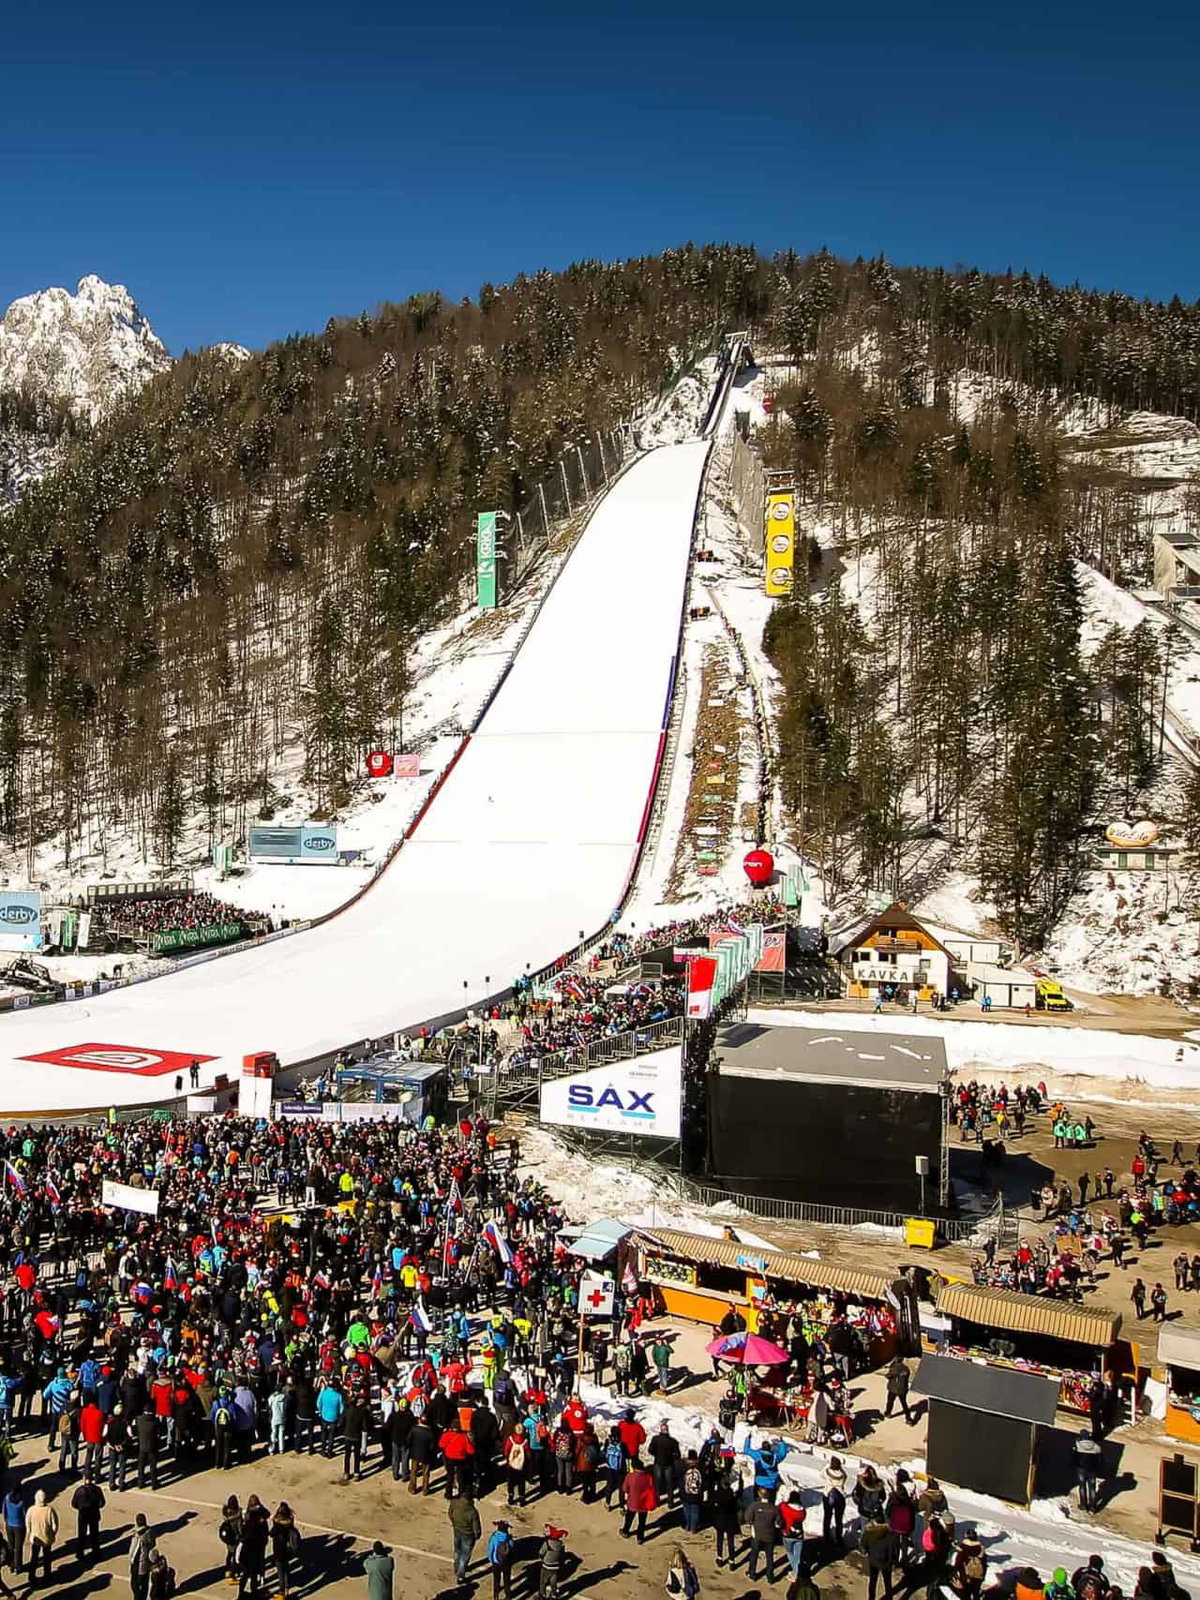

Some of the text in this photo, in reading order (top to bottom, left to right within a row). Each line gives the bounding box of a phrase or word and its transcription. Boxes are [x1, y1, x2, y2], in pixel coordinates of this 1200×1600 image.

[306, 838, 335, 849] derby
[0, 907, 35, 922] derby
[858, 969, 908, 981] KAVKA
[568, 1084, 655, 1113] SAX
